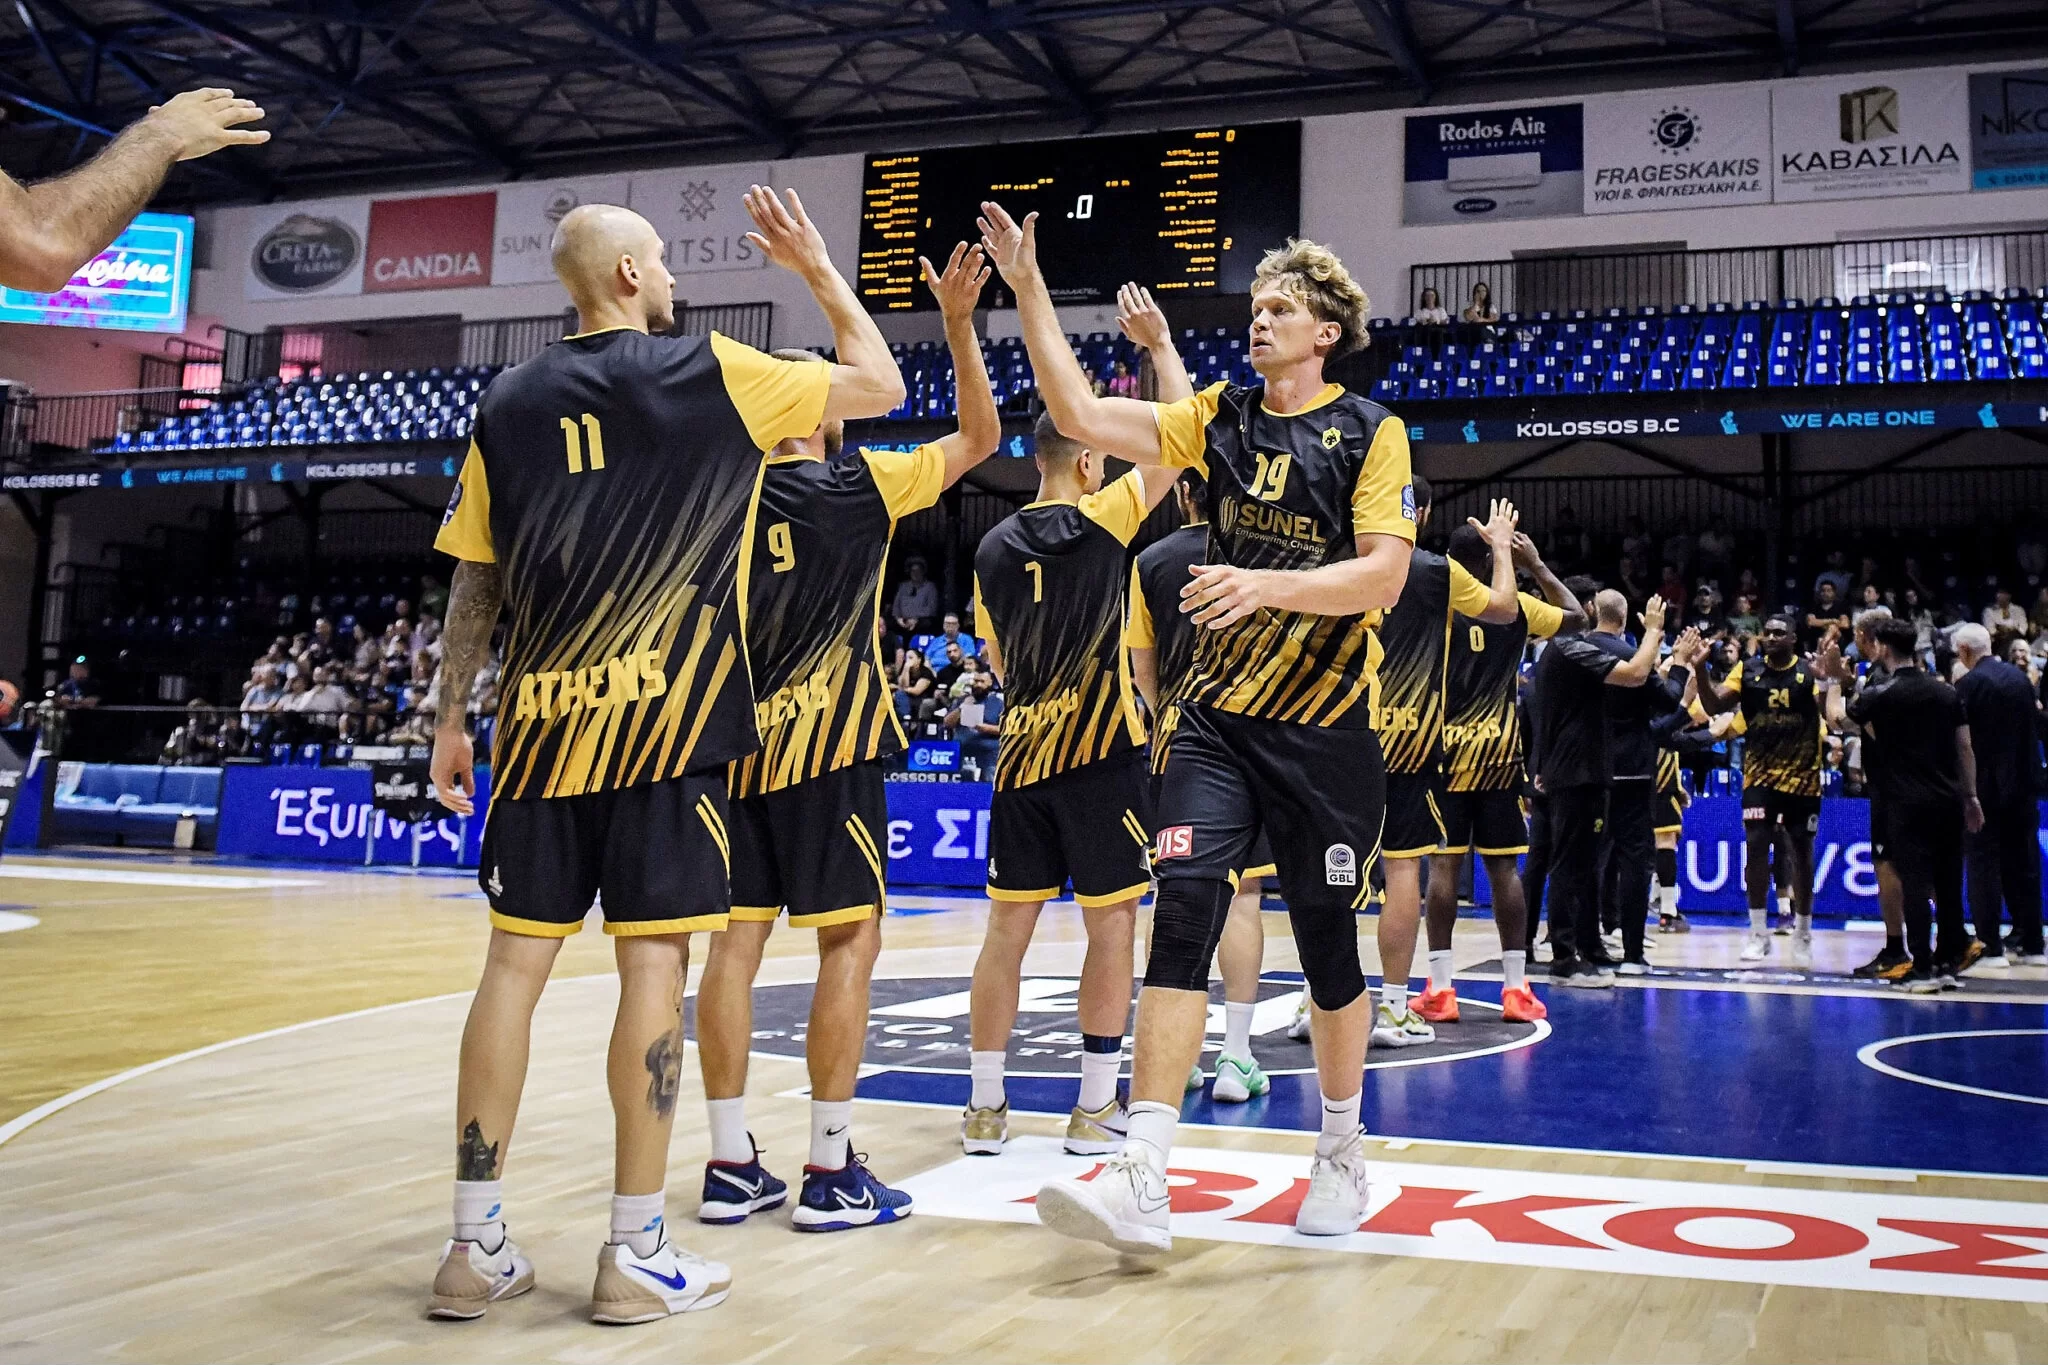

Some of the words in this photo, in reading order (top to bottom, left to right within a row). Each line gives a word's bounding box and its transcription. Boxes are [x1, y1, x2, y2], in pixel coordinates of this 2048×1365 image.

[1440, 120, 1503, 141] Rodos
[1510, 116, 1546, 136] Air
[1782, 142, 1960, 173] ΚΑΒΑΣΙΛΑ
[1595, 158, 1760, 186] FRAGESKAKIS
[502, 235, 542, 253] SUN
[661, 234, 753, 265] ITSIS
[374, 252, 482, 282] CANDIA
[1517, 419, 1638, 437] KOLOSSOS
[1643, 418, 1680, 433] B.C
[1781, 414, 1823, 429] WE
[1828, 412, 1880, 428] ARE
[1885, 410, 1935, 425] ONE
[560, 413, 605, 473] 11
[2, 473, 76, 489] KOLOSSOS
[306, 463, 388, 477] KOLOSSOS
[1247, 453, 1291, 500] 19
[1238, 503, 1327, 544] SUNEL
[768, 521, 796, 573] 9
[1235, 526, 1289, 548] Empowering
[1290, 540, 1326, 555] Change
[516, 649, 667, 721] ATHENS
[1768, 688, 1790, 708] 24
[884, 772, 937, 783] LOSSOS
[1157, 829, 1191, 860] VIS
[1330, 874, 1353, 883] GBL
